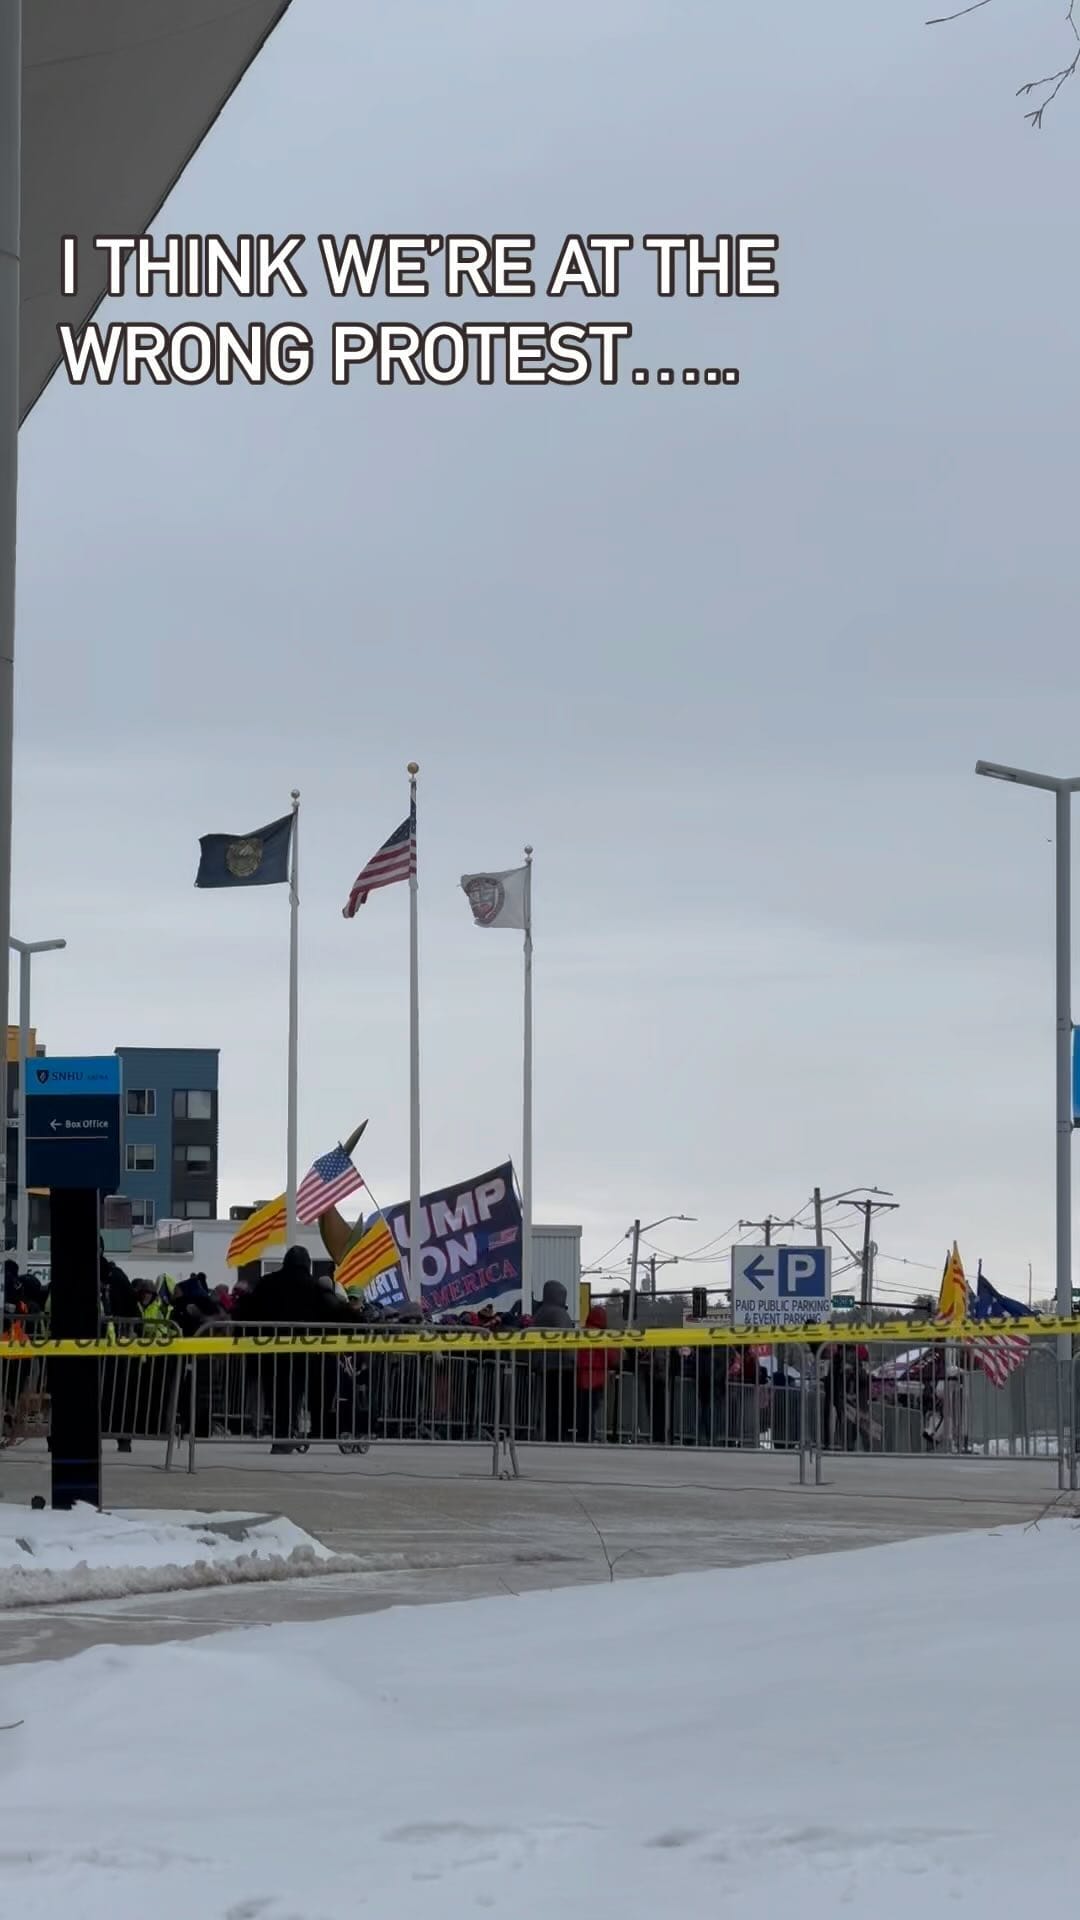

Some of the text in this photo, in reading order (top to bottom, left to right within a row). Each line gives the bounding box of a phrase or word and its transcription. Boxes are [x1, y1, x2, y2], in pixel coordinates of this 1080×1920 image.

[52, 1071, 83, 1081] SNHU
[65, 1119, 109, 1129] Box Office
[787, 1254, 816, 1292] P
[735, 1299, 756, 1312] PAID
[759, 1299, 789, 1312] PUBLIC
[791, 1299, 830, 1312] PARKING
[744, 1312, 821, 1325] & EVENT PARKING
